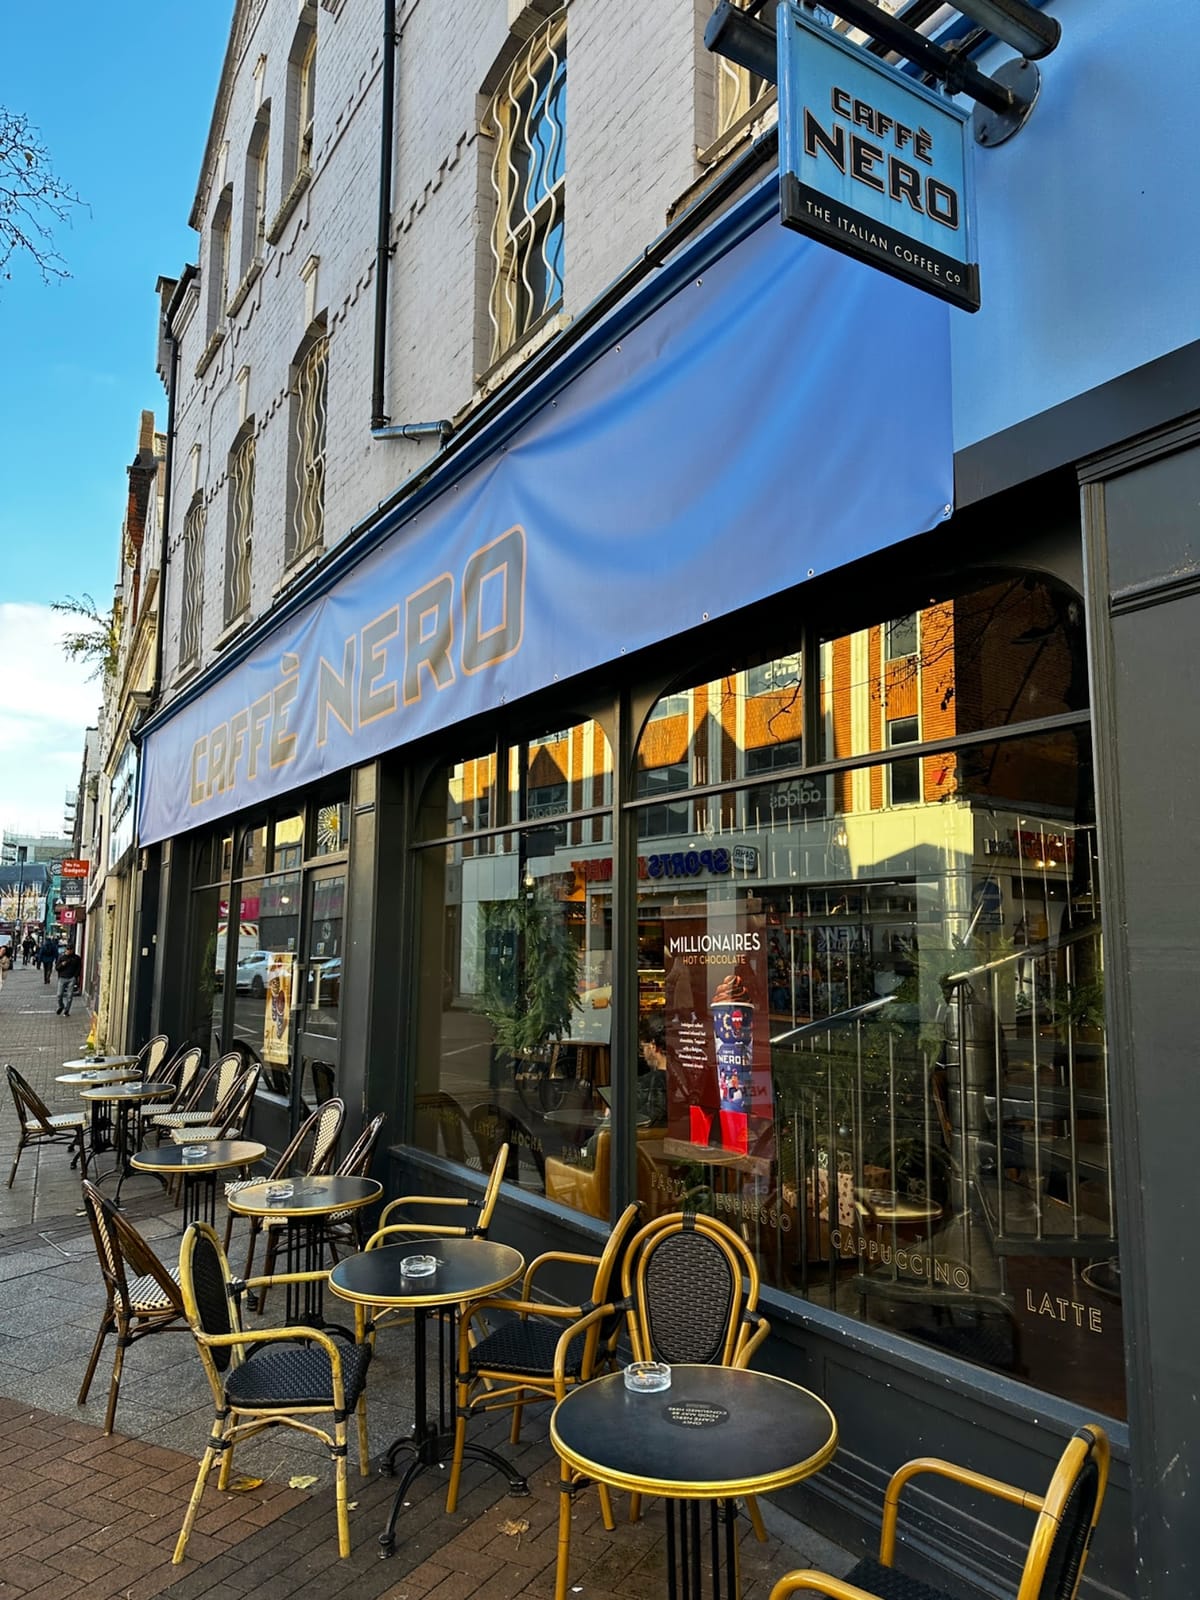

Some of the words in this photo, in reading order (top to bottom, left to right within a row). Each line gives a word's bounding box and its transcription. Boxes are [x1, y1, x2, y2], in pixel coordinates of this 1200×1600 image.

[831, 86, 933, 166] CAFFÈ
[803, 105, 960, 231] NERO
[806, 201, 832, 223] THE
[838, 216, 889, 251] ITALIAN
[894, 245, 941, 276] COFFEE
[190, 652, 300, 807] CAFFÈ
[316, 524, 527, 748] NERO
[669, 932, 761, 953] MILLIONAIRES
[682, 954, 698, 966] HOT
[699, 953, 746, 966] CHOCOLATE
[718, 1055, 742, 1065] NERO
[511, 1130, 544, 1153] MOCHA
[716, 1192, 792, 1233] ESPRESSO
[831, 1229, 971, 1290] CAPPUCCINO
[1026, 1287, 1103, 1334] LATTE
